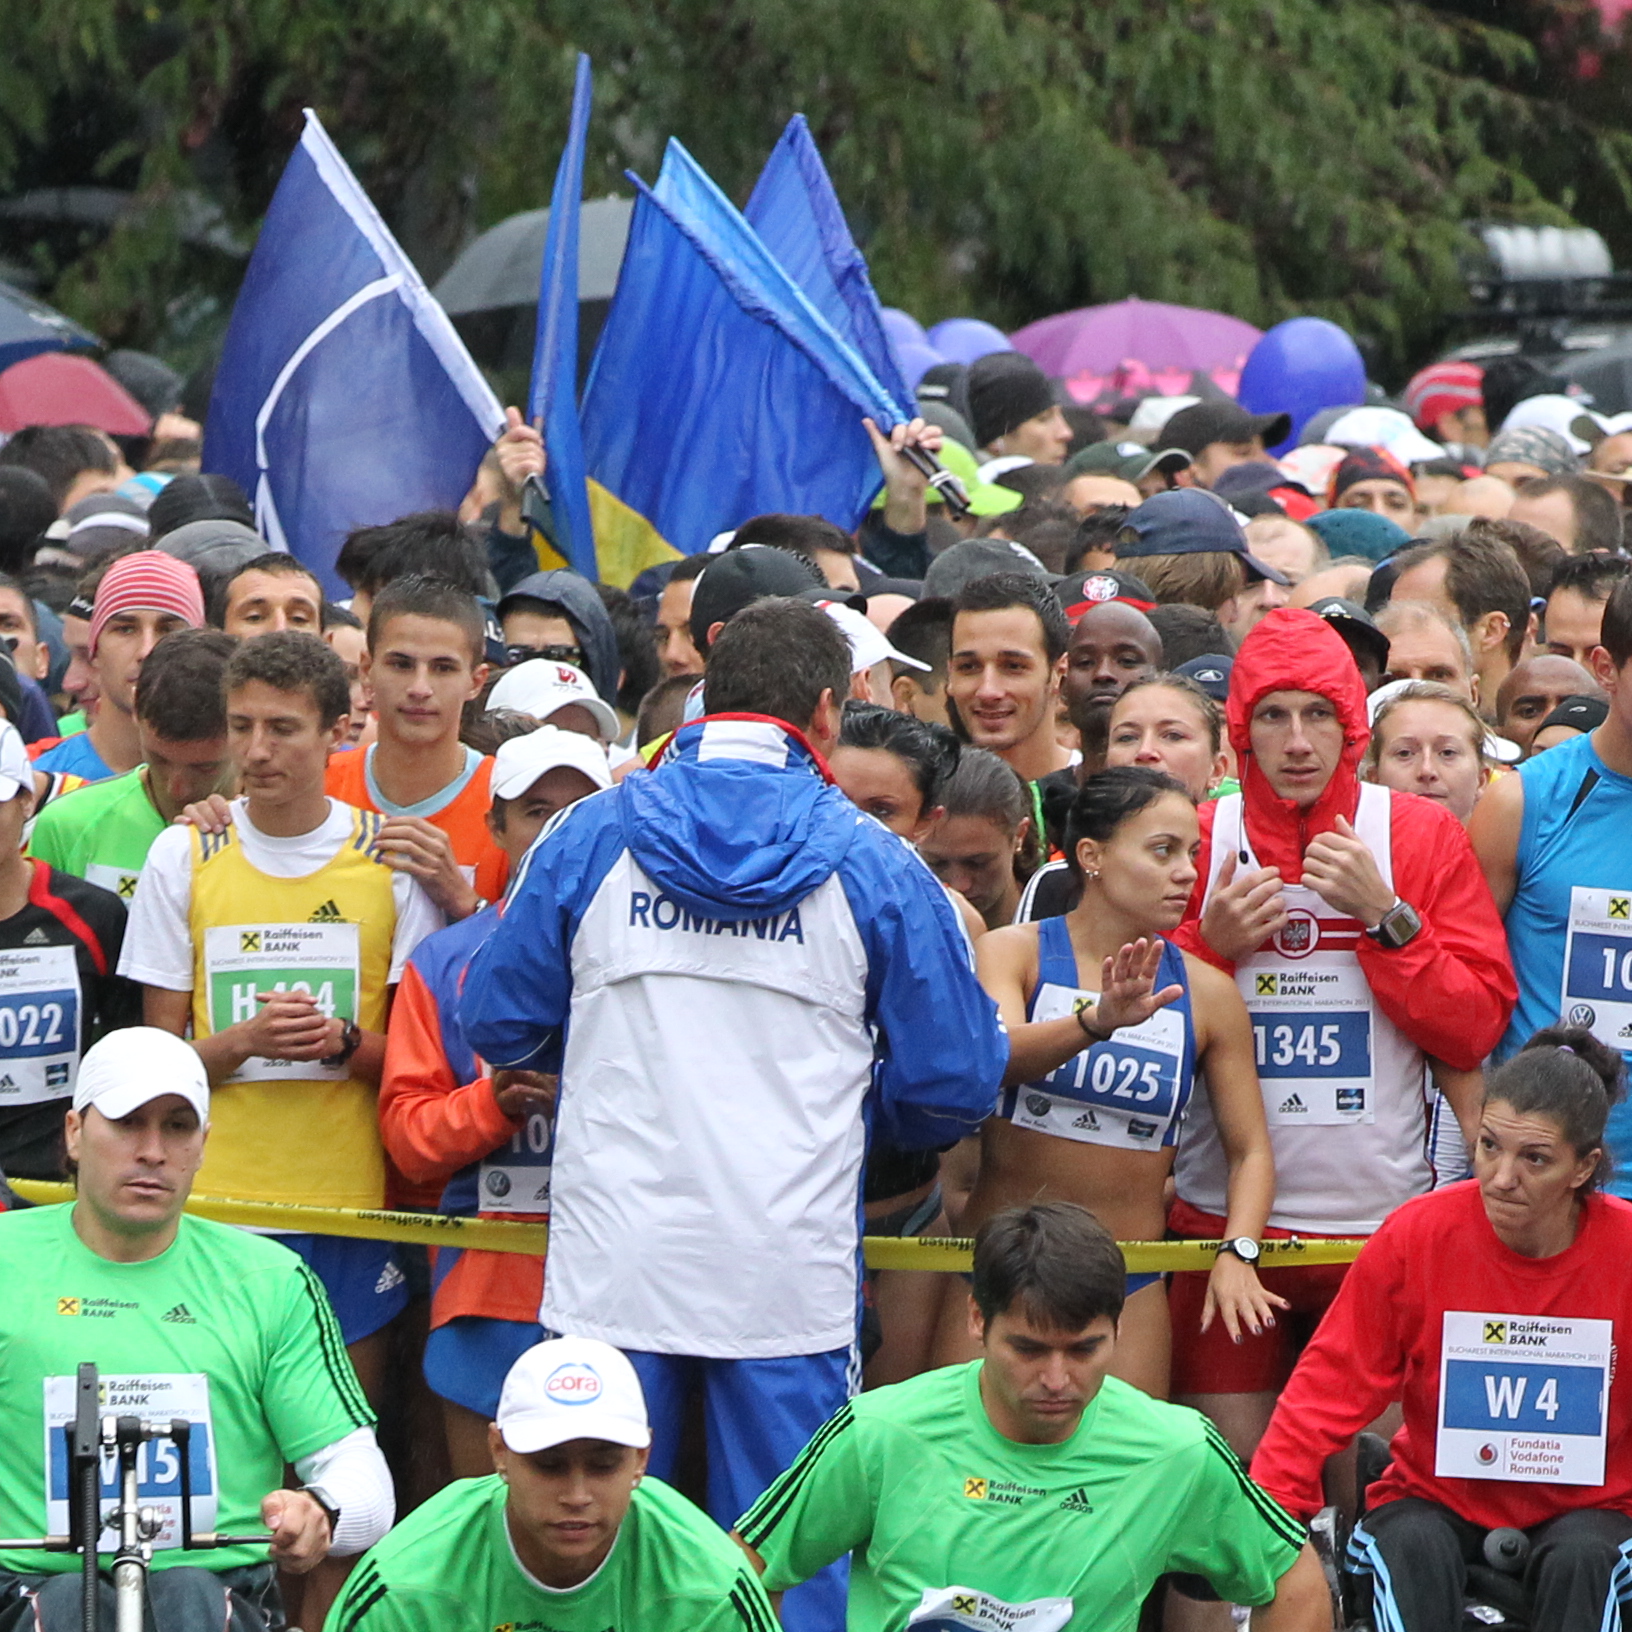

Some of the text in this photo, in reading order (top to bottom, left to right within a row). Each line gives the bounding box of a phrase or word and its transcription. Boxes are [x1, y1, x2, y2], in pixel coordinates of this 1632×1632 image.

[263, 929, 323, 940] Raiffeisen
[264, 942, 301, 952] BANK
[1280, 972, 1339, 983] Raiffeisen
[1280, 985, 1317, 996] BANK
[232, 983, 257, 1024] H
[1253, 1024, 1341, 1066] 1345
[357, 1210, 434, 1227] Raiffeisen
[918, 1237, 974, 1252] iffeisen
[81, 1297, 140, 1309] Raiffeisen
[81, 1309, 116, 1318] BANK
[1510, 1322, 1572, 1335] Raiffeisen
[1509, 1335, 1548, 1346] BANK
[109, 1380, 172, 1391] Raiffeisen
[547, 1376, 597, 1392] cora
[109, 1395, 150, 1405] BANK
[1484, 1375, 1559, 1421] W 4
[1511, 1438, 1561, 1450] Fundatia
[1510, 1451, 1564, 1463] Vodafone
[1510, 1464, 1560, 1475] Romania
[989, 1479, 1046, 1496] Raiffeisen
[988, 1493, 1023, 1505] BANK
[1059, 1501, 1093, 1514] adidas
[980, 1598, 1036, 1620] Raiffeisen
[978, 1609, 1016, 1631] BANK
